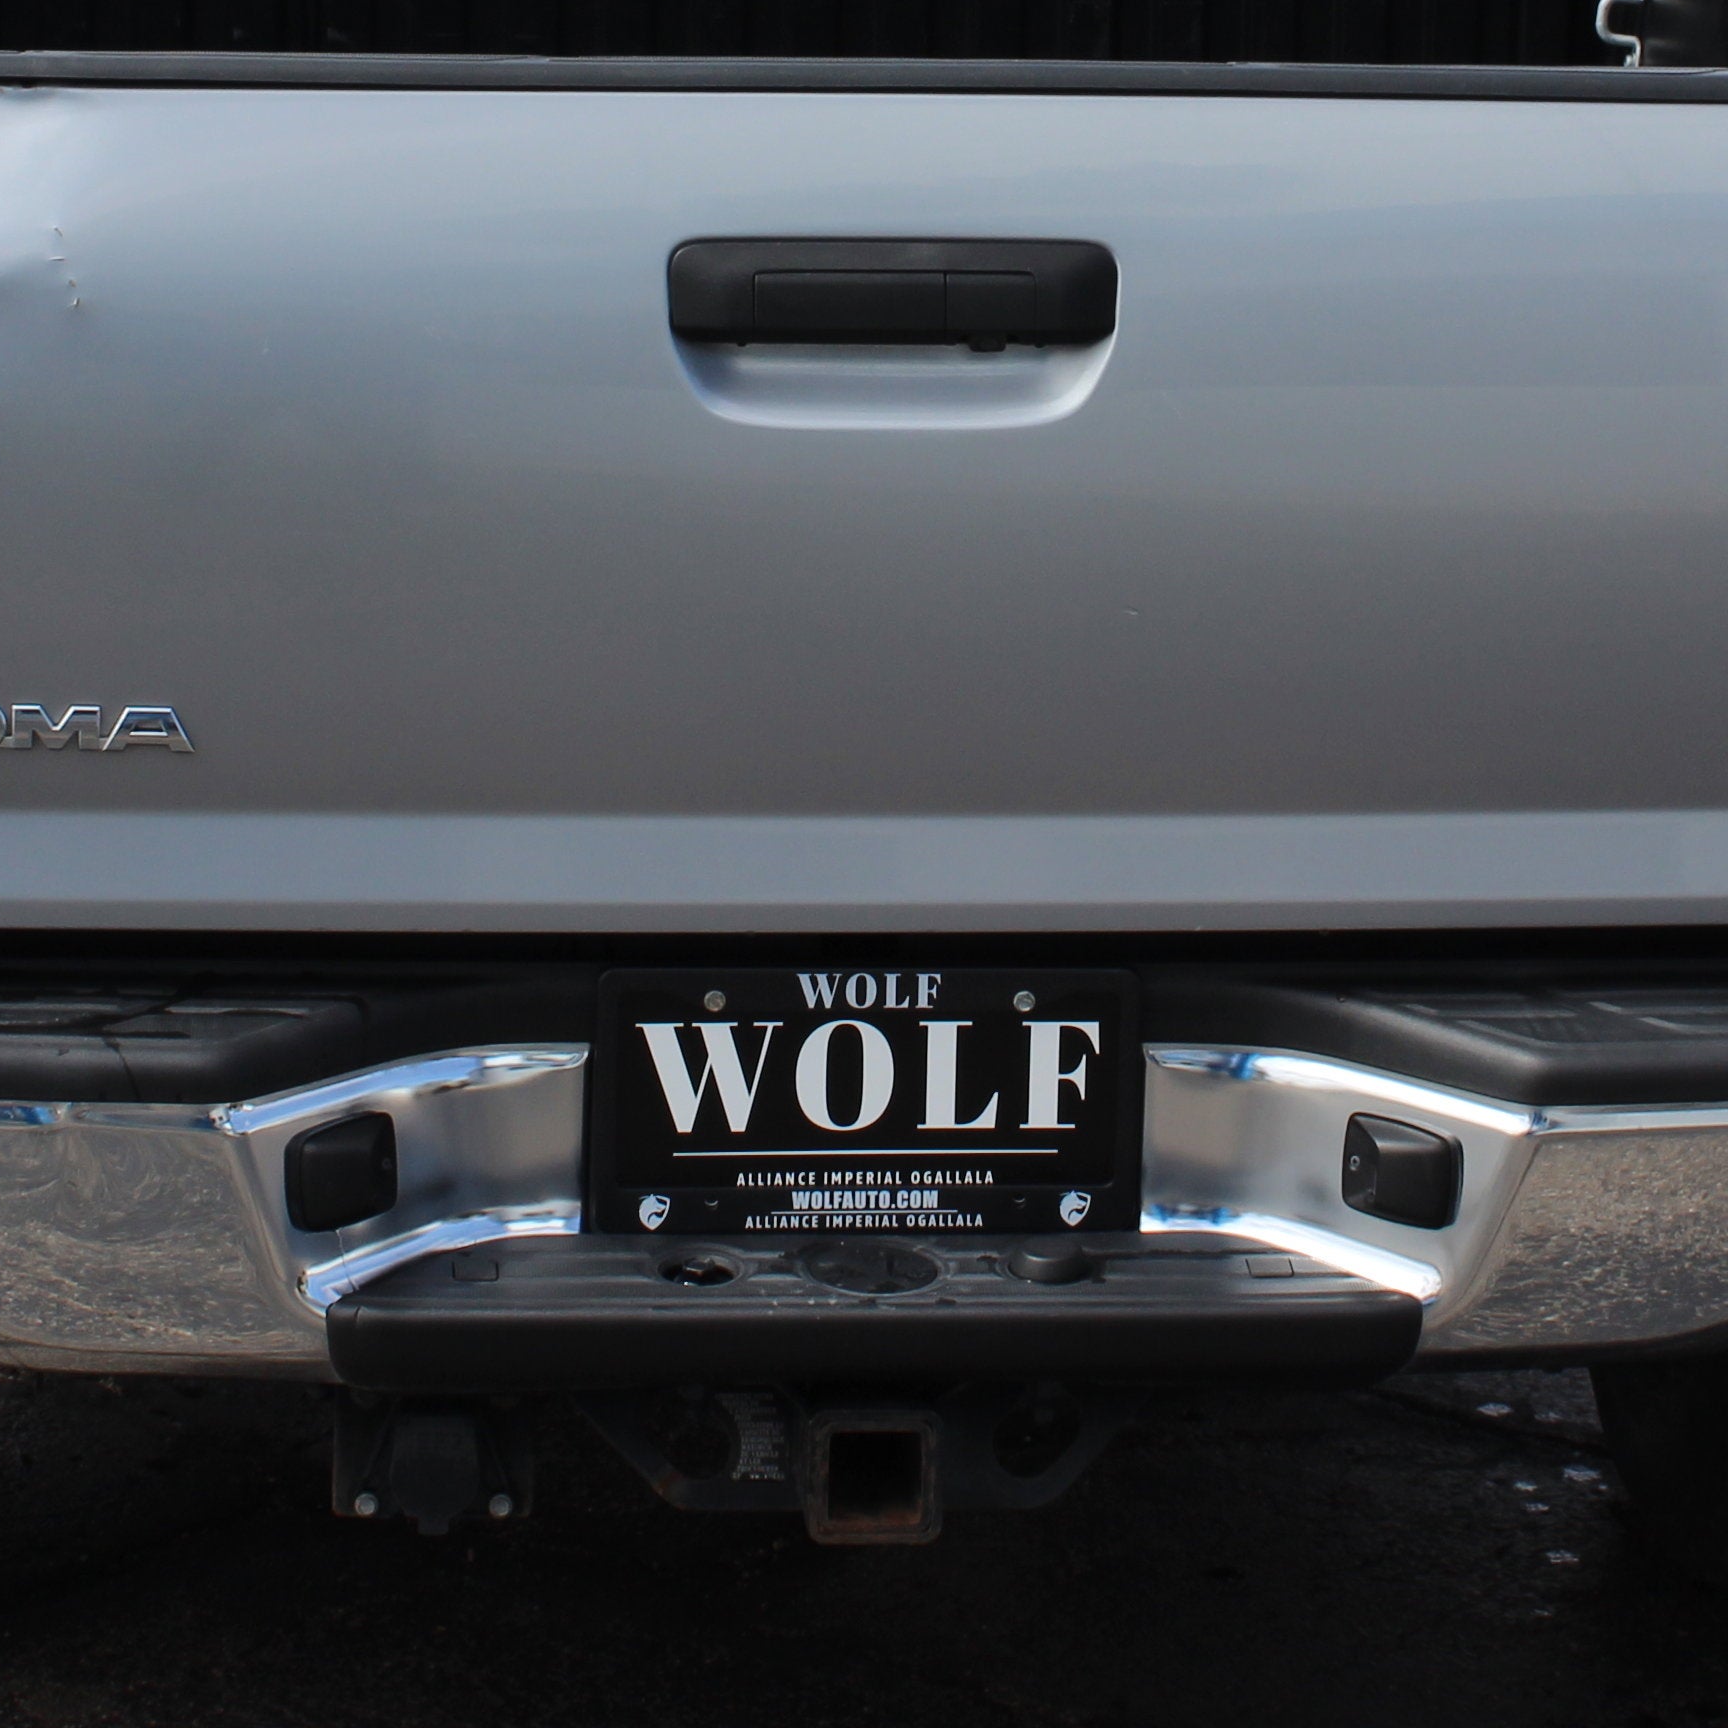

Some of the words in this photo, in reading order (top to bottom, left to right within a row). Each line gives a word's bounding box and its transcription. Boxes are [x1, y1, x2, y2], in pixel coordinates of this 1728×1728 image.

[797, 973, 942, 1009] WOLF
[635, 1020, 1101, 1133] WOLF
[736, 1172, 816, 1187] ALLIANCE
[823, 1171, 903, 1186] IMPERIAL
[910, 1170, 994, 1186] OGALLALA
[791, 1190, 939, 1210] WOLFAUTO.COM
[745, 1215, 820, 1229] ALLIANCE
[825, 1214, 899, 1229] IMPERIAL
[906, 1213, 984, 1228] OGALLALA
